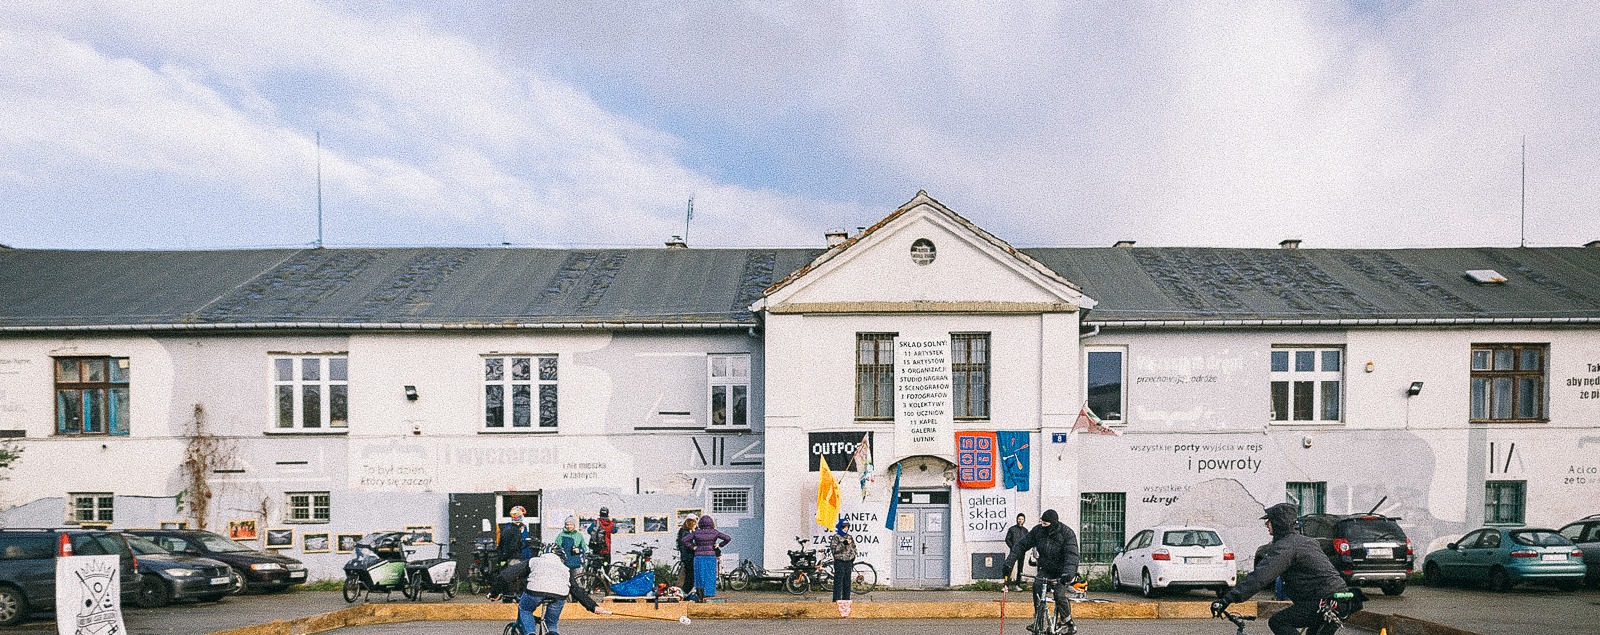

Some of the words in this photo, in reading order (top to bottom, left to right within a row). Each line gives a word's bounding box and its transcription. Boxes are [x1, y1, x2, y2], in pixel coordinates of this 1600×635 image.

[1566, 376, 1582, 387] aby
[1057, 435, 1063, 443] 8
[812, 441, 863, 455] OUTPO
[1130, 443, 1172, 453] wszystkie
[1174, 443, 1200, 453] porty
[1246, 443, 1263, 453] rejs
[1188, 456, 1192, 471] i
[1198, 456, 1262, 474] powroty
[1568, 465, 1575, 474] A
[968, 494, 1007, 509] galeria
[838, 513, 878, 521] LANETA
[968, 507, 1008, 520] skład
[968, 519, 1008, 533] solny
[813, 534, 880, 545] ZASONA
